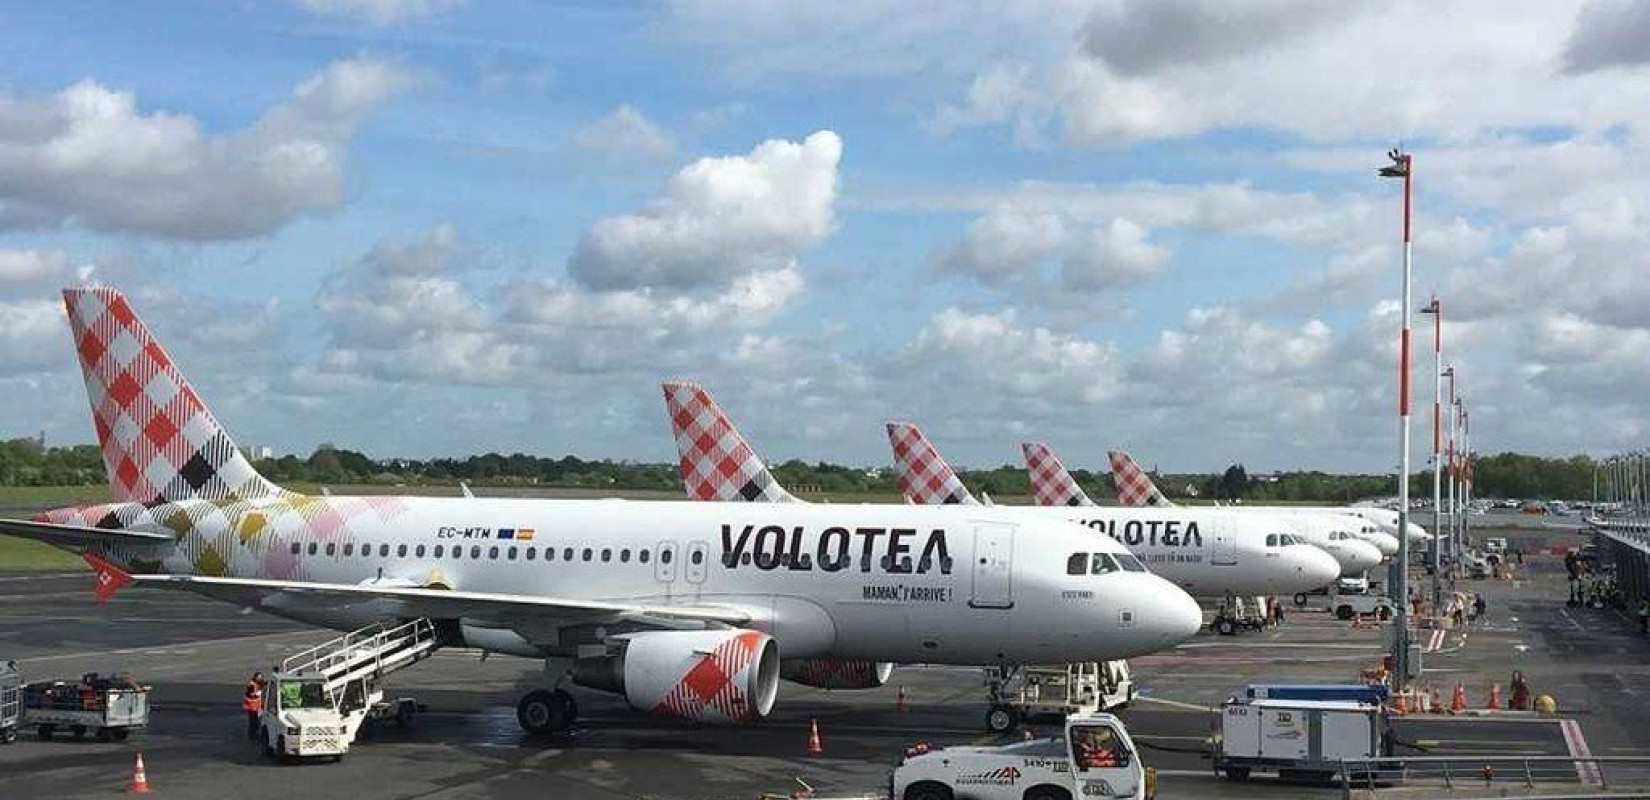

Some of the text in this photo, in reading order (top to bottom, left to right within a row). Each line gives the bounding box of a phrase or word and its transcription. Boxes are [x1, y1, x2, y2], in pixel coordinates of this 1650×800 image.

[438, 527, 490, 538] EC-MTM
[1066, 519, 1202, 547] LOTEA
[721, 524, 953, 575] VOLOTEA
